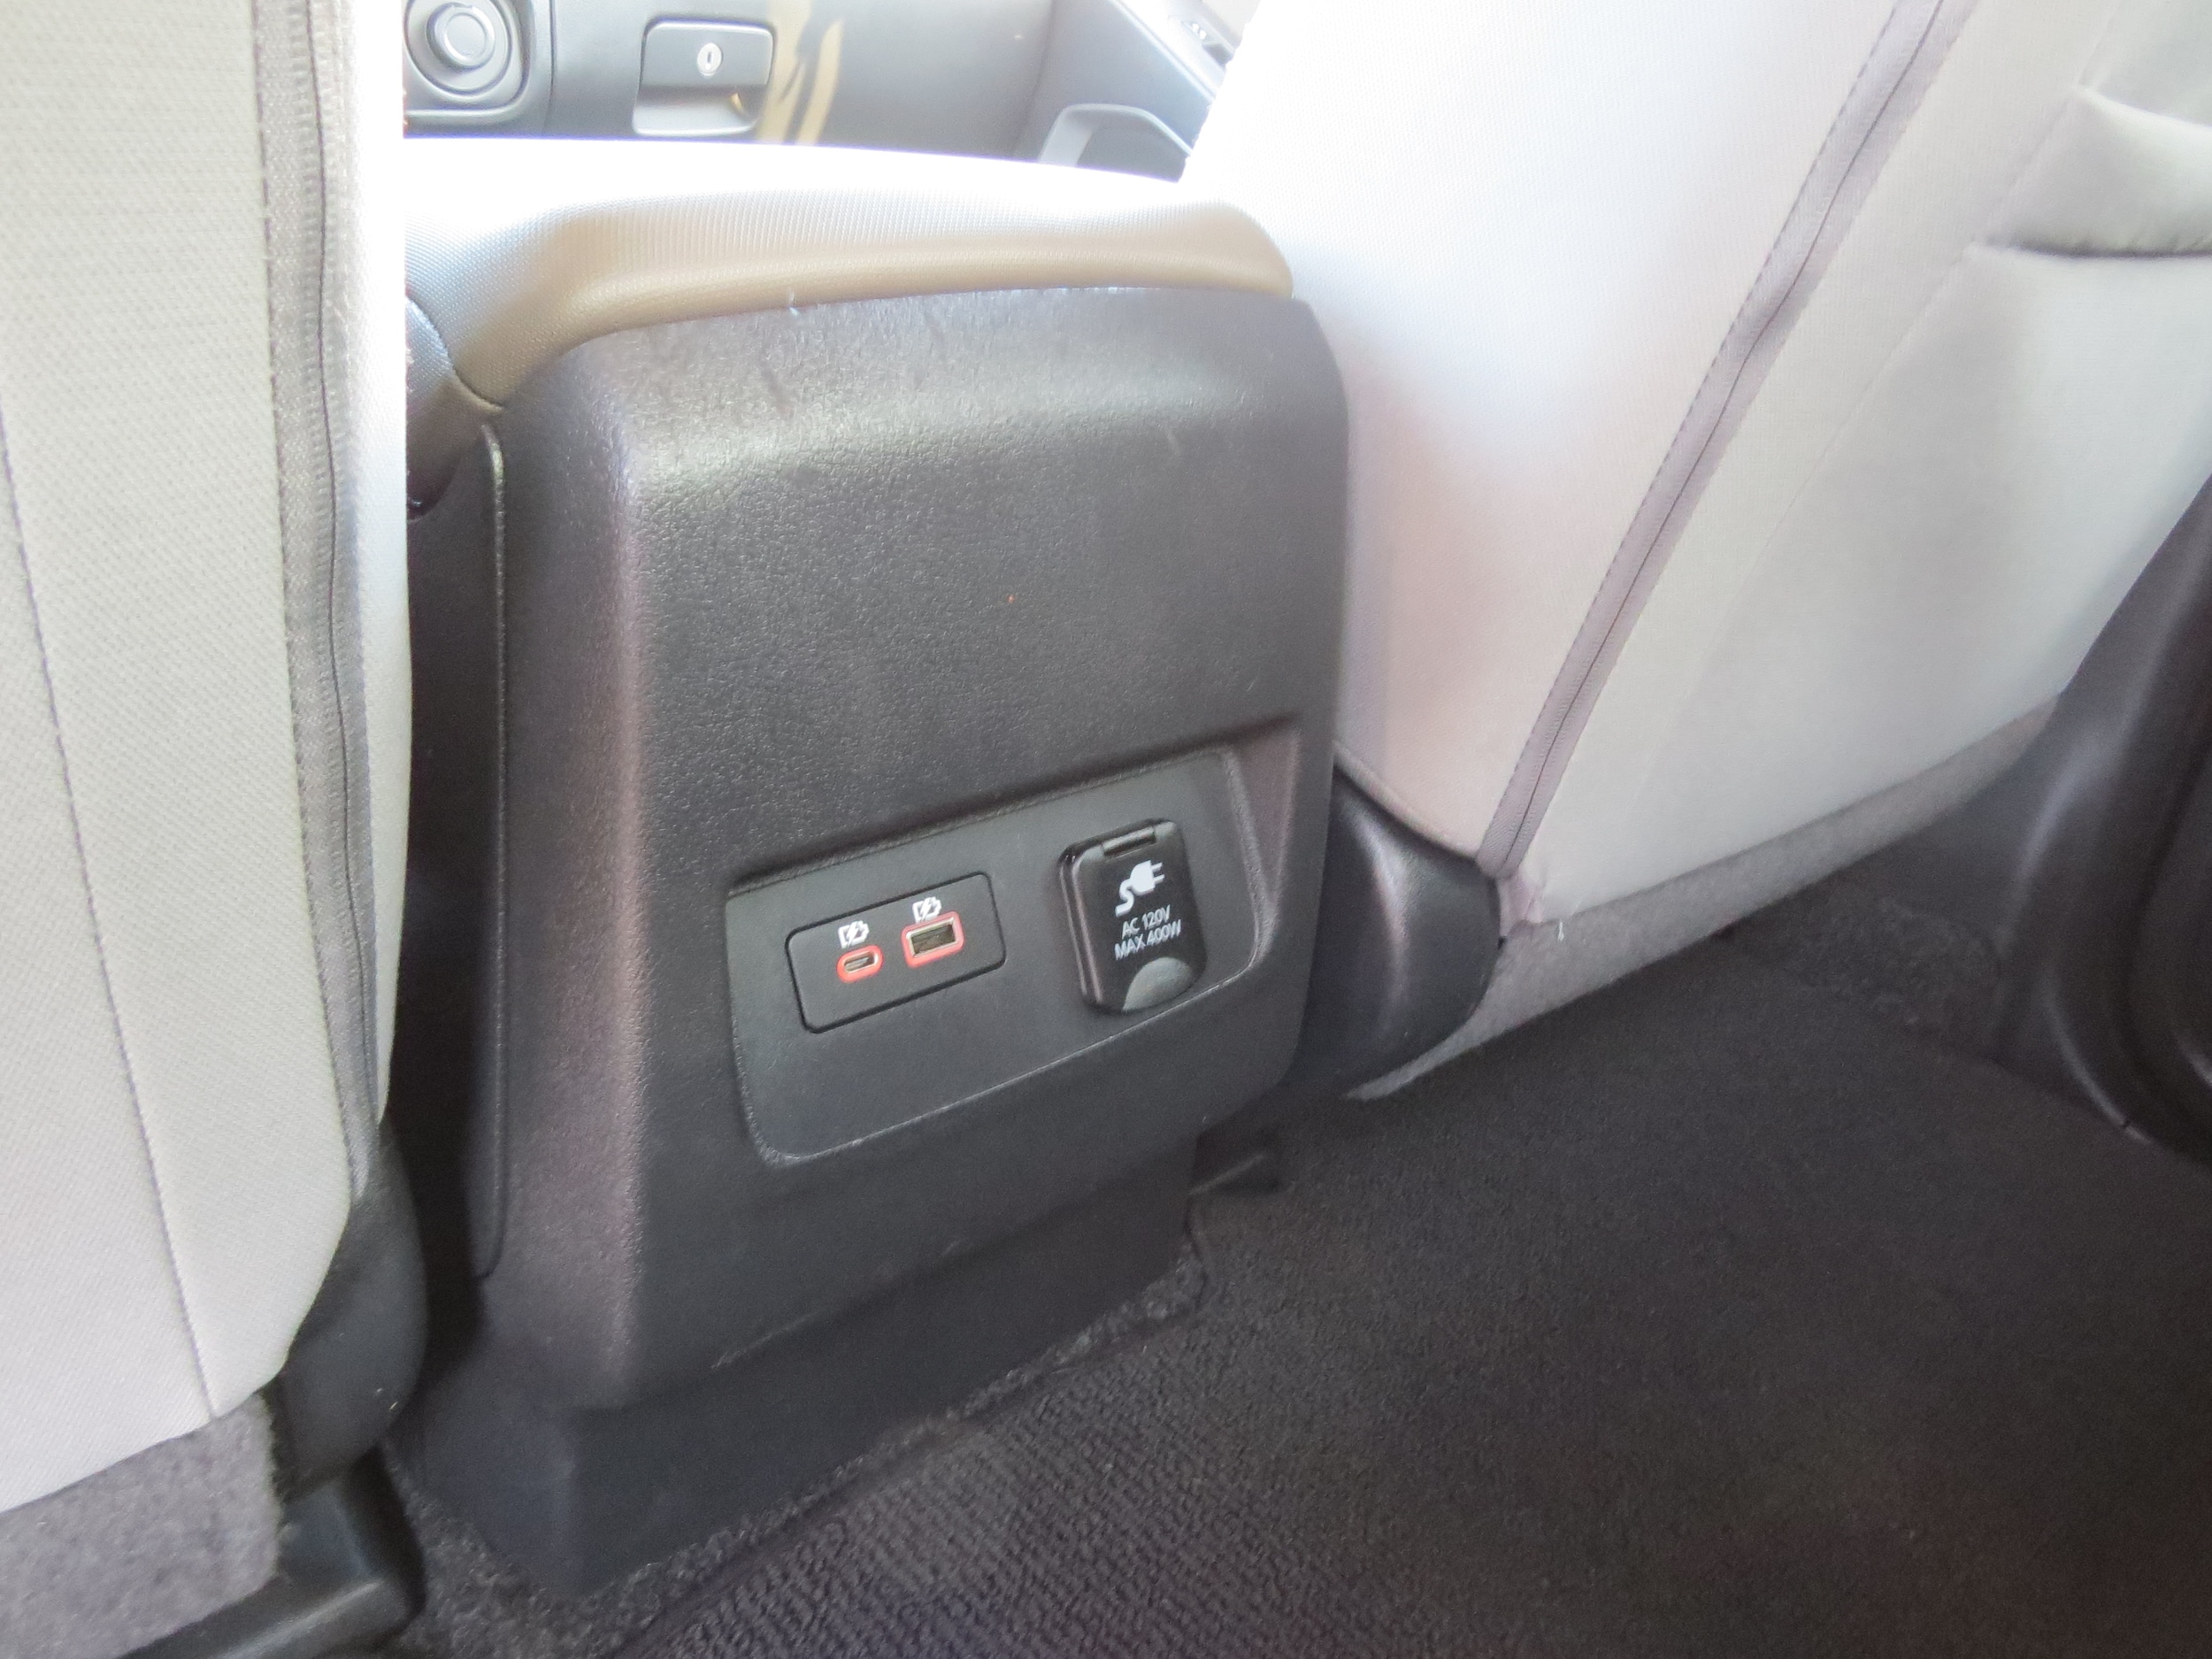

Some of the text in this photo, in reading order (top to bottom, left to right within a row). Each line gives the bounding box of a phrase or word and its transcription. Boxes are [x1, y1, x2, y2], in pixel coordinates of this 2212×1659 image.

[1122, 904, 1171, 940] AC 120V
[1147, 918, 1181, 947] 400W
